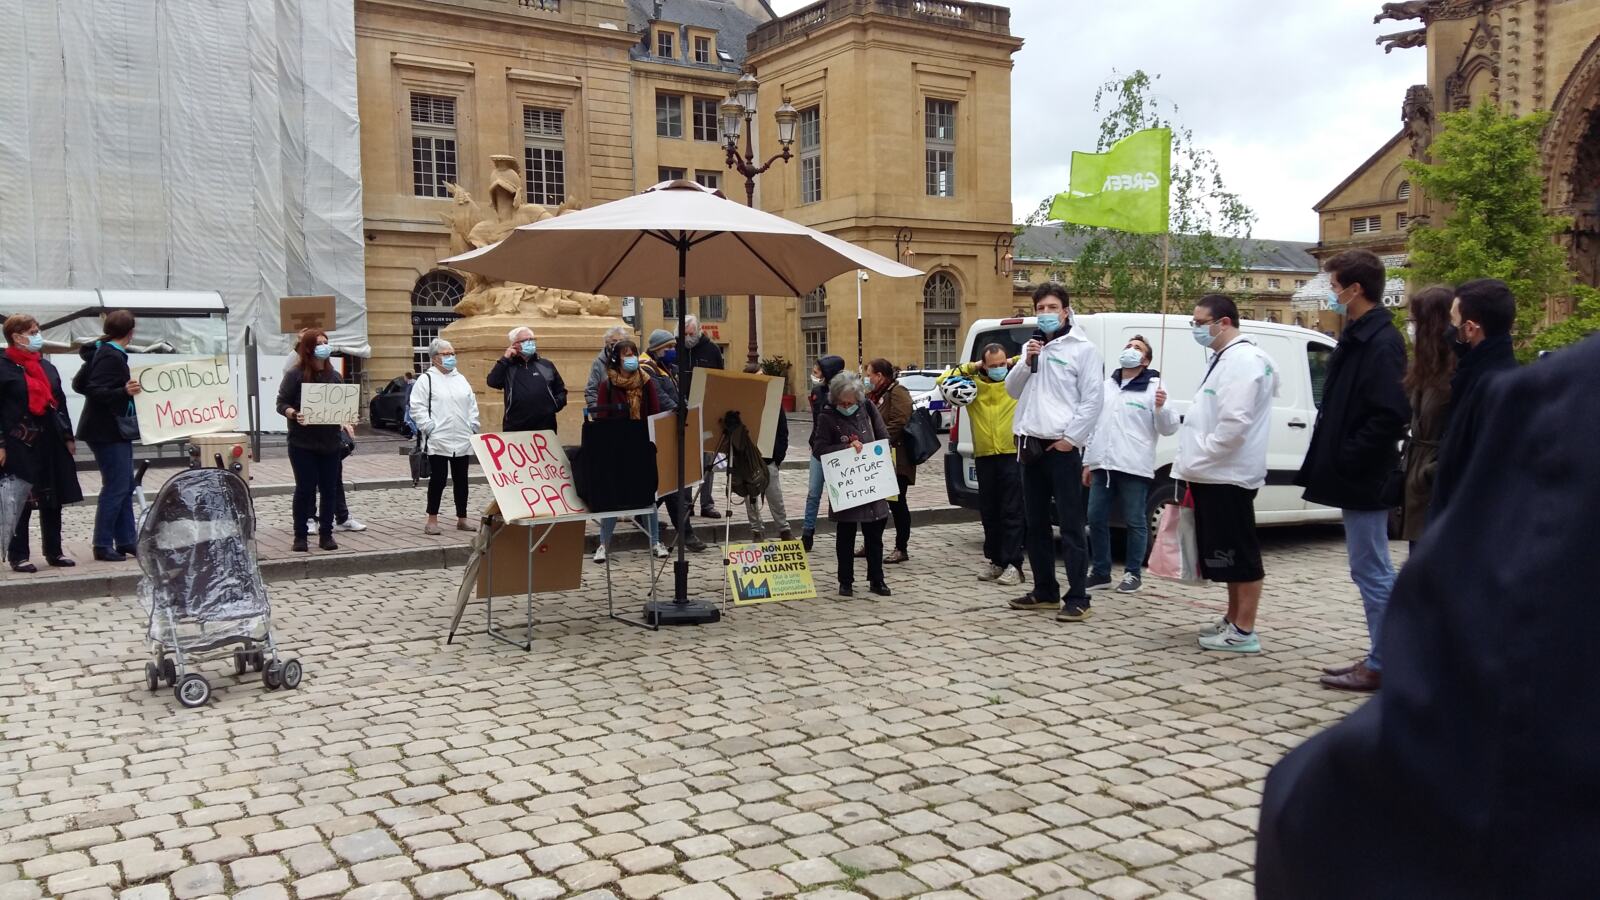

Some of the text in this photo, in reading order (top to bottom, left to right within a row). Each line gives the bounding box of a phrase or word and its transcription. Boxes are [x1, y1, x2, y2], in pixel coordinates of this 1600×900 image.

[139, 358, 230, 393] Combat
[306, 384, 359, 405] STOP
[155, 397, 238, 428] Monsanto
[480, 433, 559, 471] POUR
[854, 454, 867, 462] DE
[491, 463, 571, 488] UNE AUTRE
[840, 461, 884, 478] NATURE
[837, 472, 879, 488] PAS DE
[520, 483, 585, 518] PAC
[845, 485, 877, 500] FUTUR
[761, 543, 801, 553] NON AUX
[728, 549, 762, 565] STOP
[763, 552, 804, 563] REJETS
[743, 562, 806, 575] POLLUANTS
[747, 586, 768, 598] KNAUF
